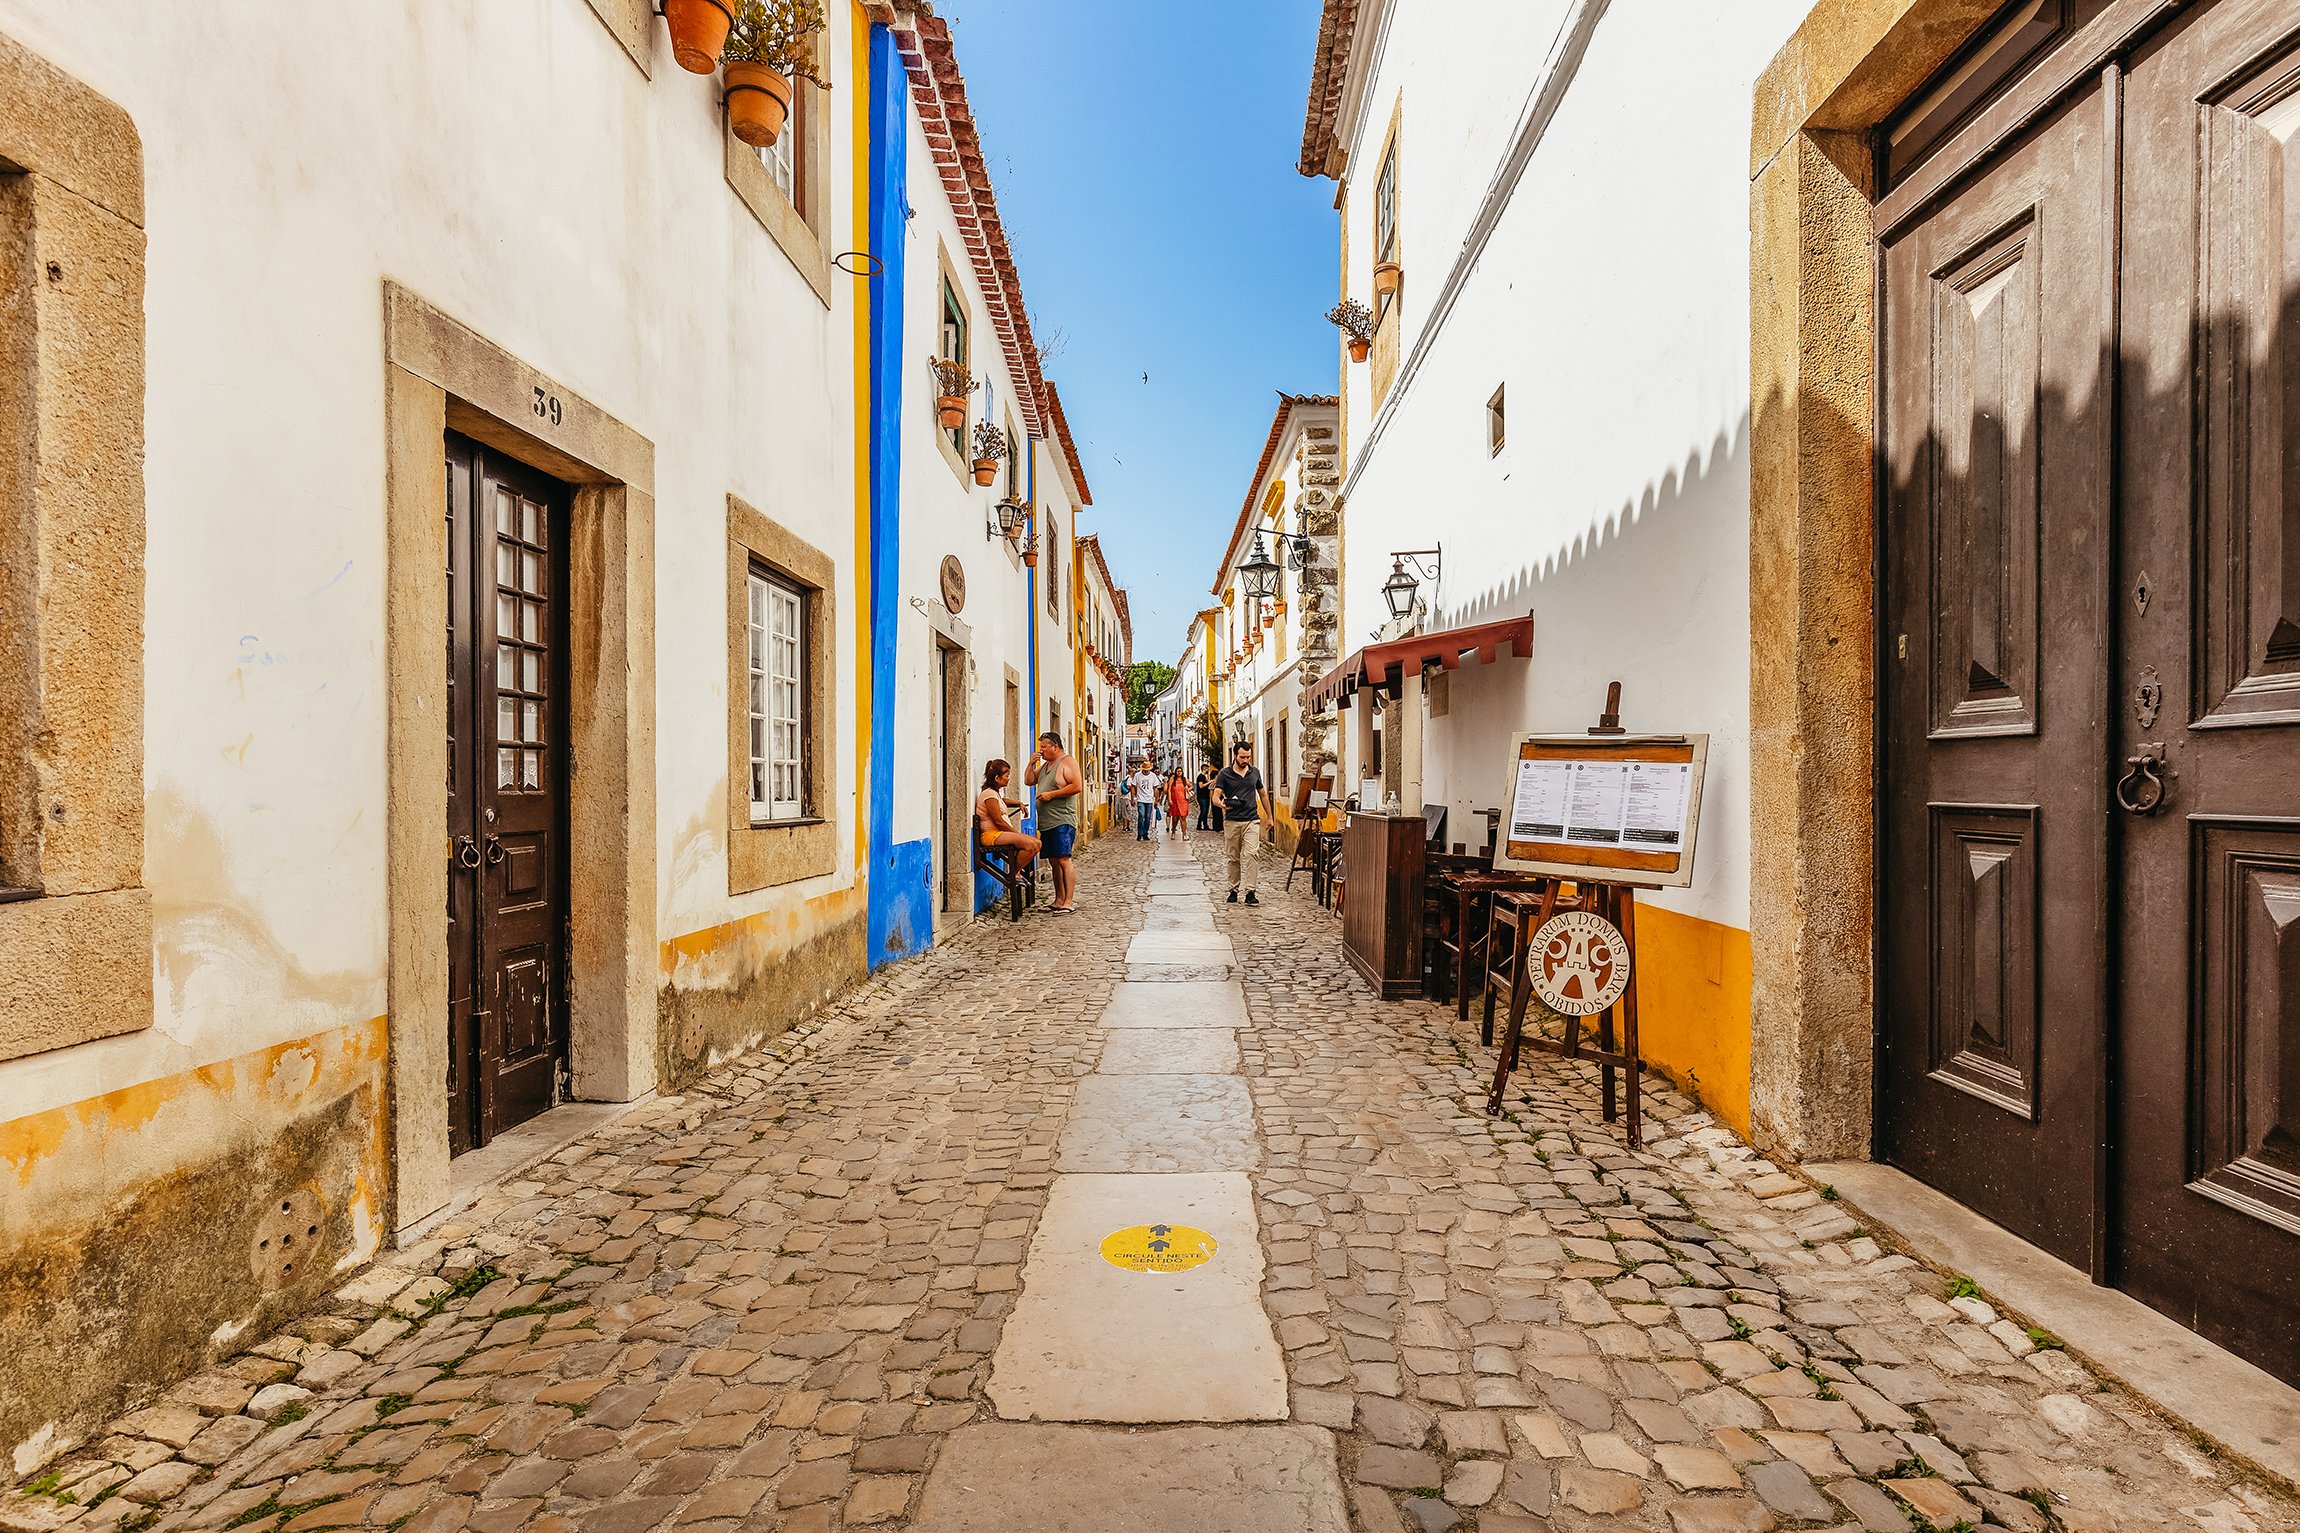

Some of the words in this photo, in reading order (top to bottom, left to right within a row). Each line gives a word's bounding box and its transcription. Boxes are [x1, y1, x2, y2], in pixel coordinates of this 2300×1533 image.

[533, 386, 562, 426] 39
[1530, 914, 1571, 983] PETRARUM
[1577, 912, 1626, 955] DOMUS
[1606, 963, 1628, 994] BAR
[1543, 990, 1604, 1014] OBIDOS
